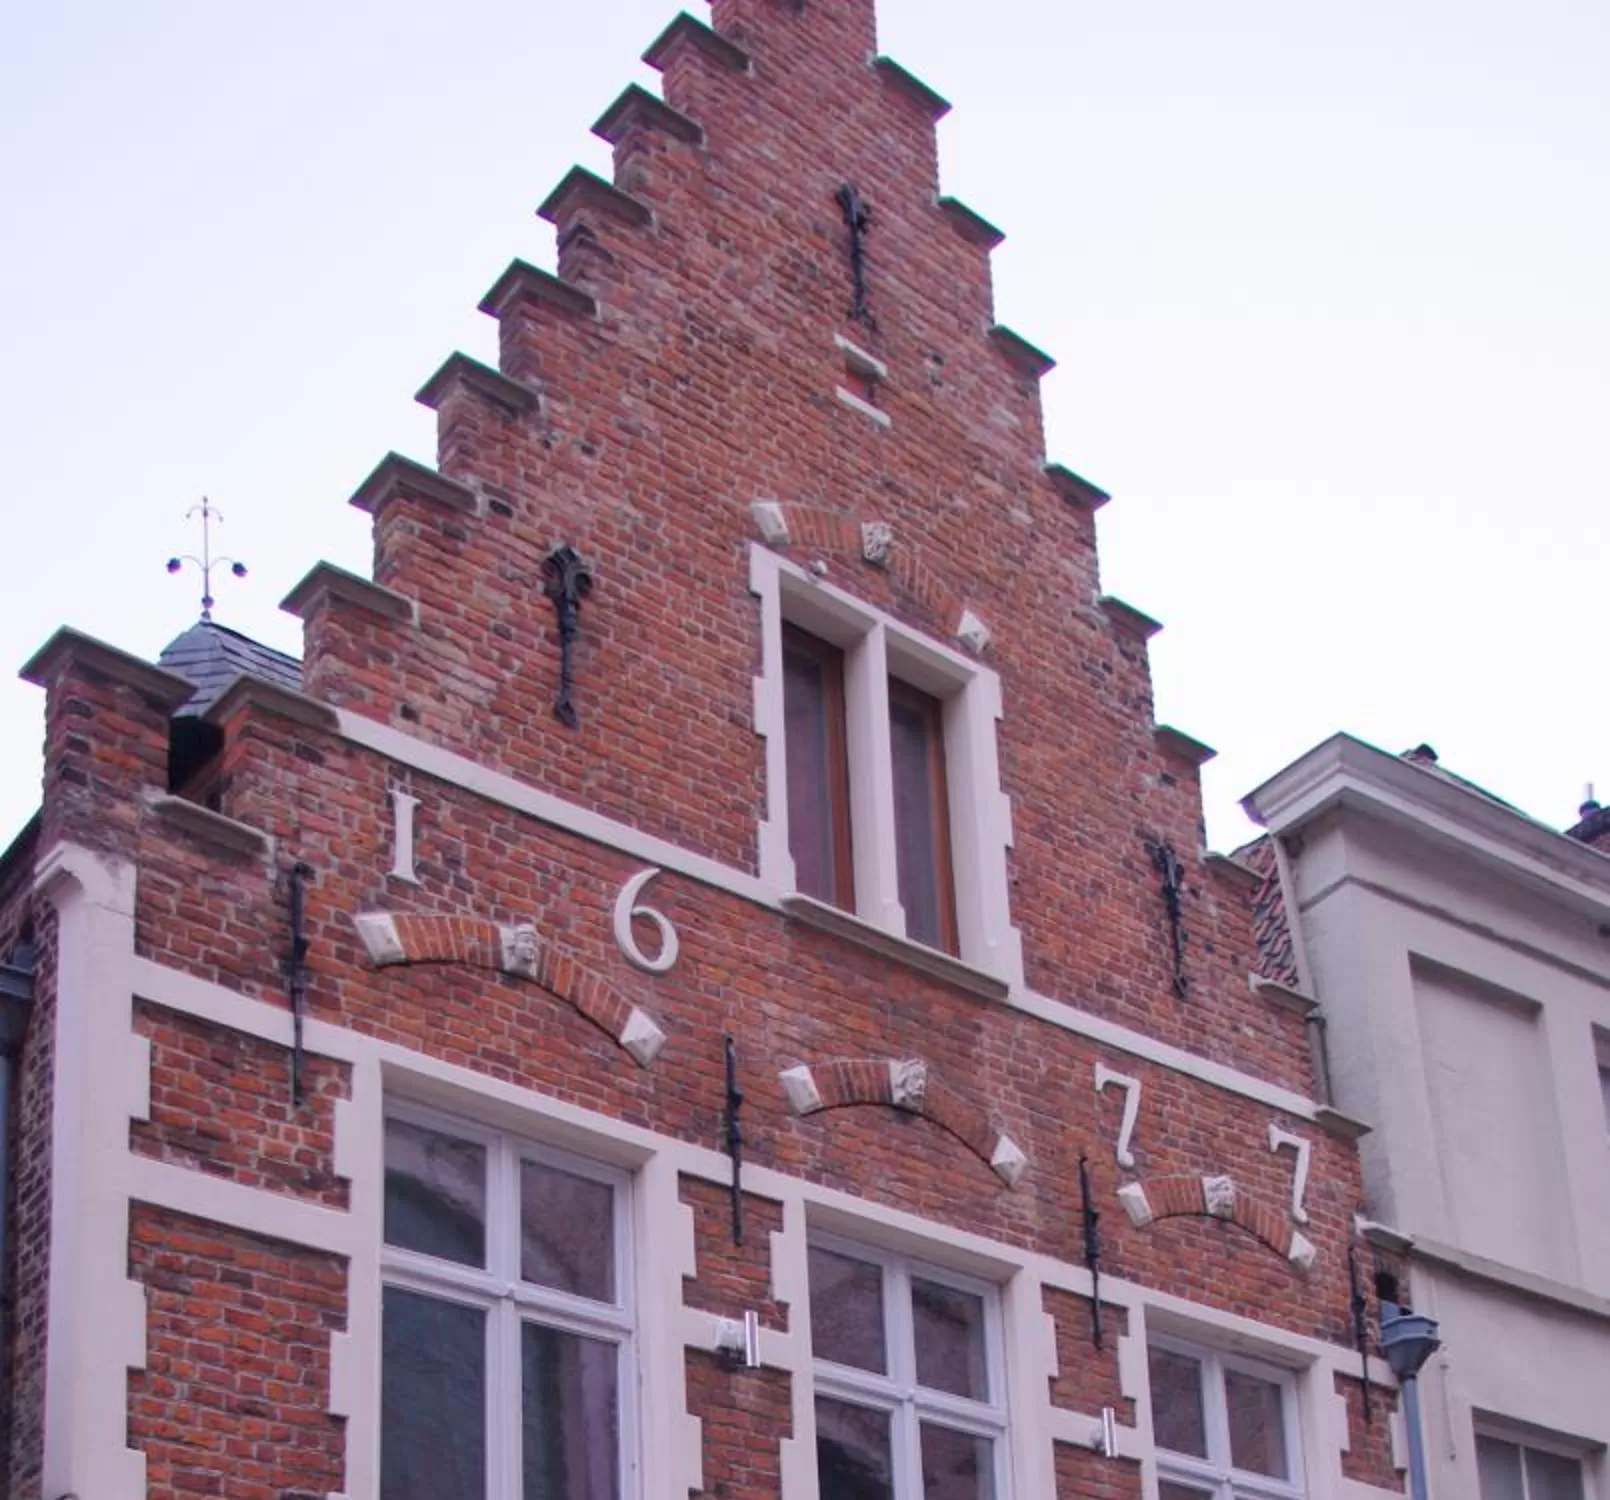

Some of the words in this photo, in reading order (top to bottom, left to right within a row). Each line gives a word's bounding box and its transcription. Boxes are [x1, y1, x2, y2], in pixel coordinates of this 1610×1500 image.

[613, 867, 679, 973] 6
[1095, 1061, 1141, 1167] 7
[1268, 1123, 1311, 1224] 7
